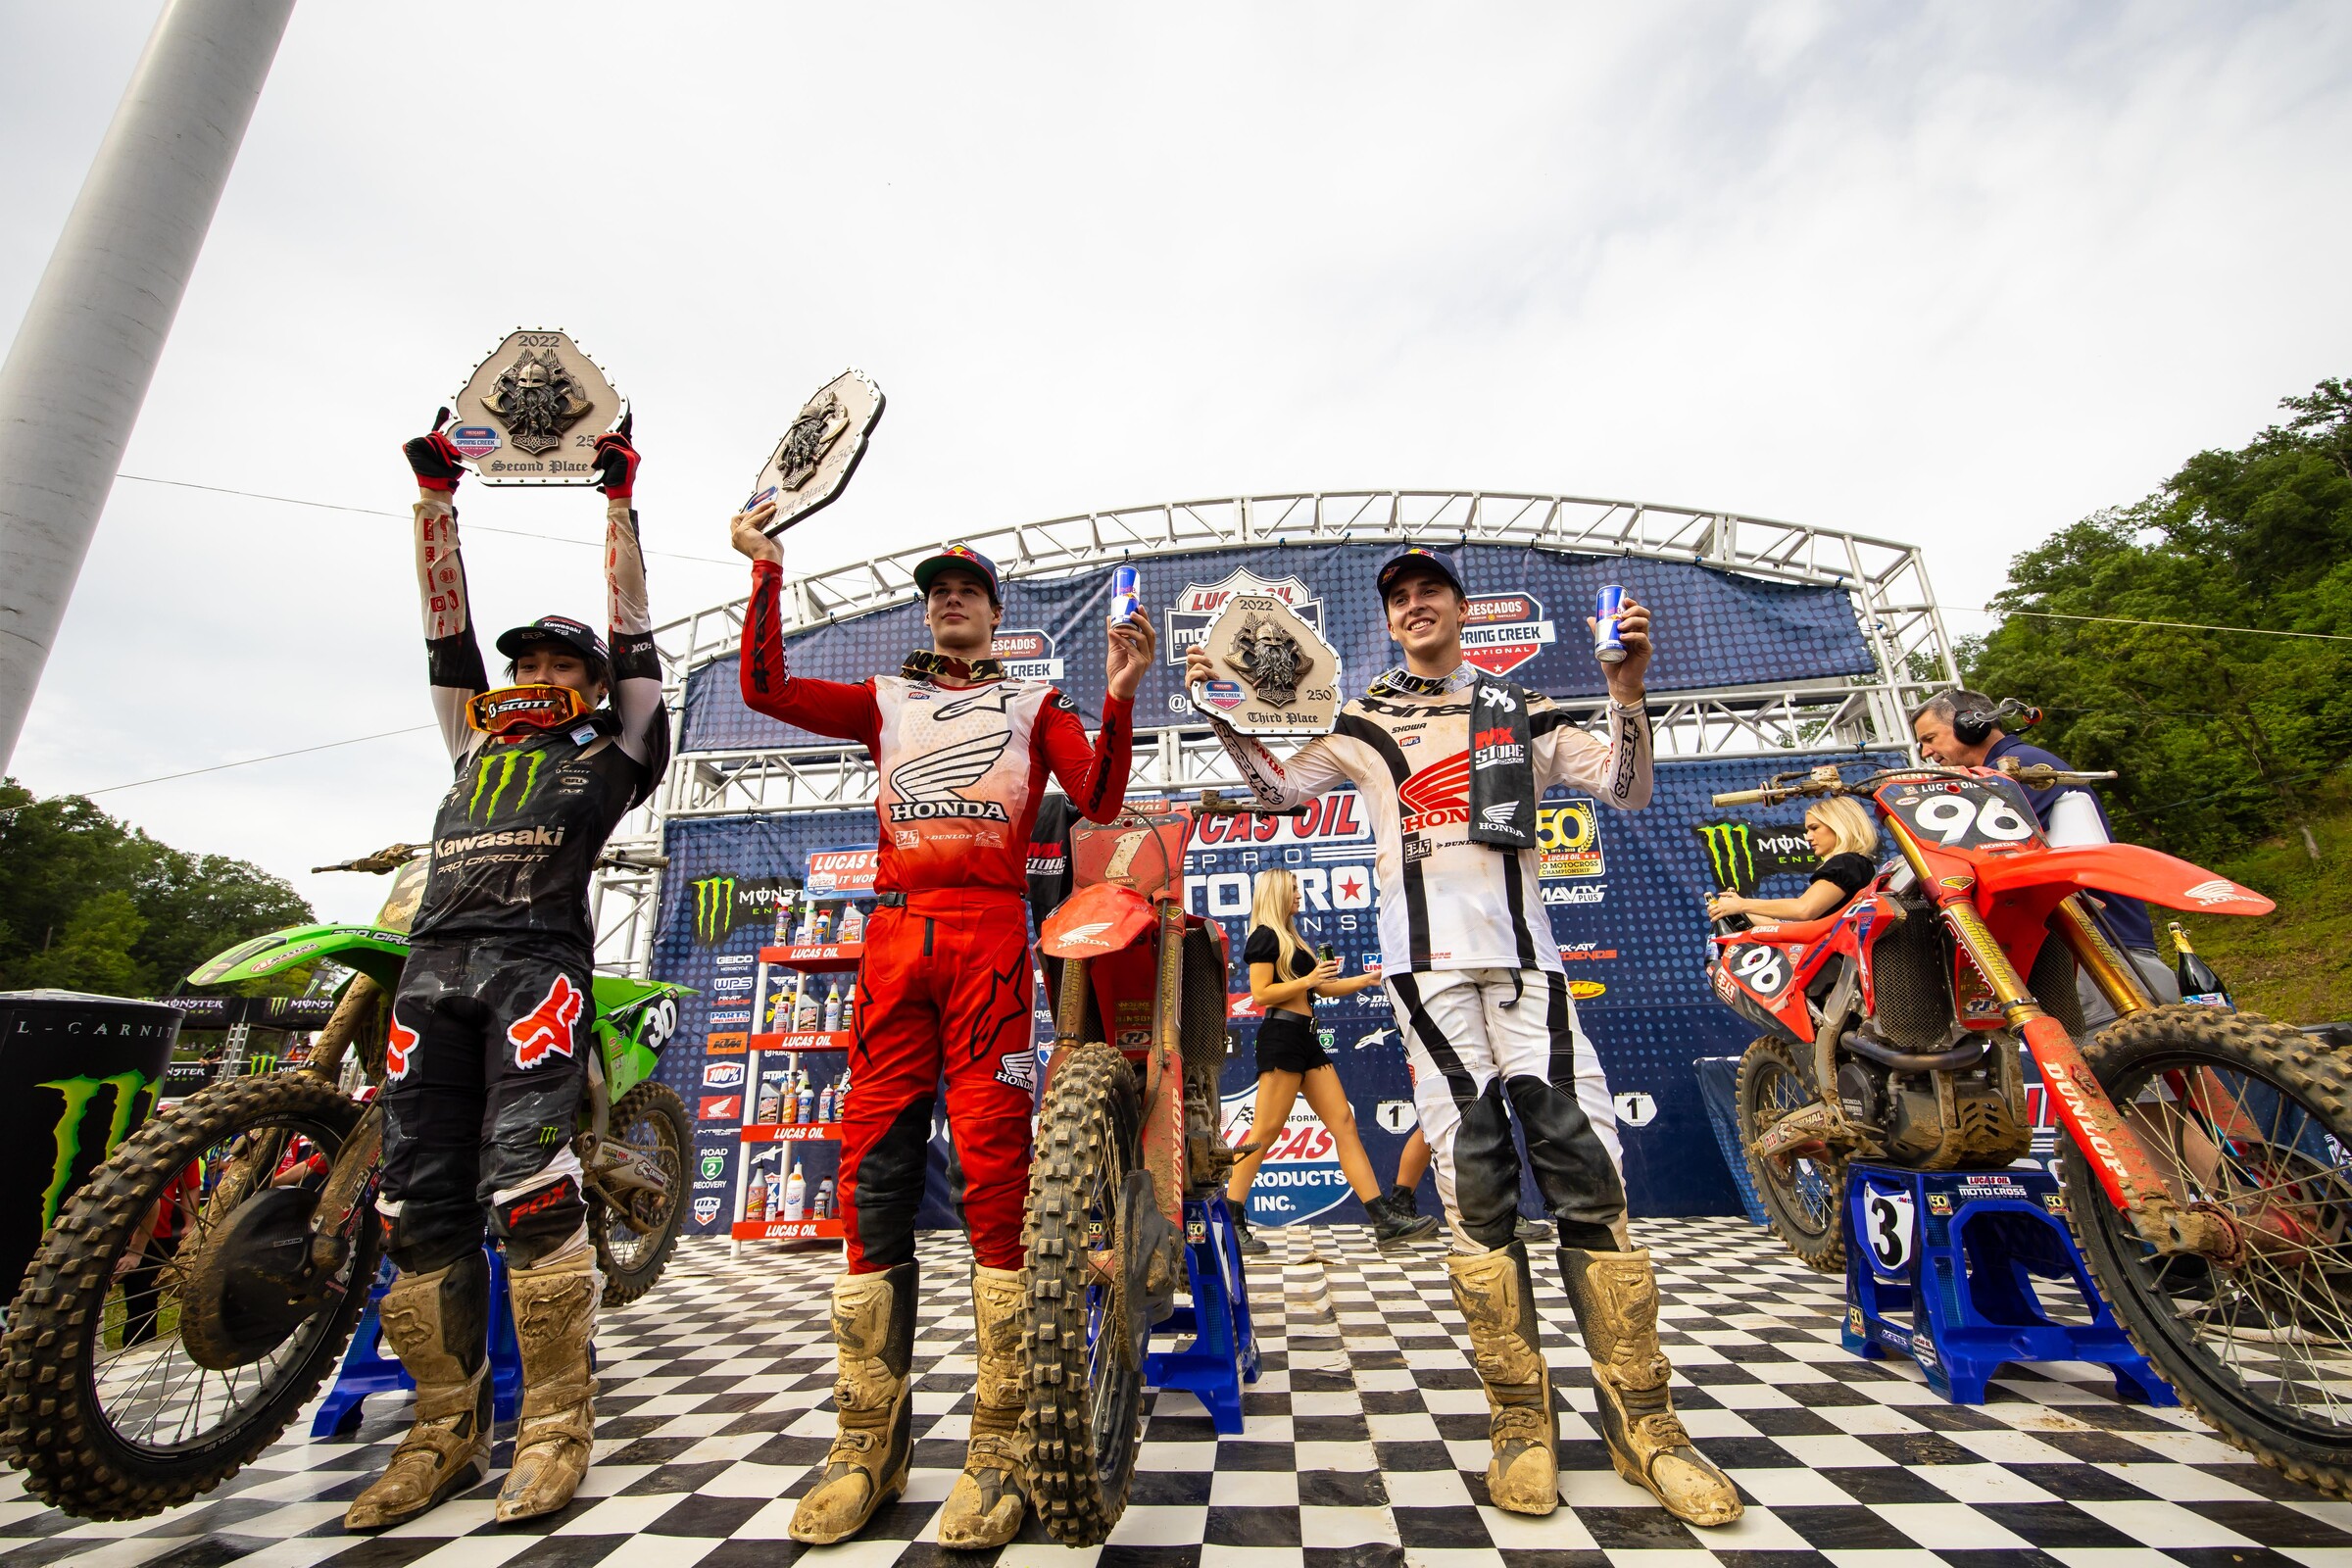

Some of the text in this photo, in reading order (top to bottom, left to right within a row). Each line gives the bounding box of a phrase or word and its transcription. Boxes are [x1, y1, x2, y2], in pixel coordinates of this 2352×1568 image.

[517, 334, 561, 348] 2022
[491, 460, 588, 474] Second Place
[798, 480, 828, 507] Place
[1239, 599, 1274, 612] 2022
[544, 621, 581, 635] Kawasaki
[1497, 625, 1542, 642] CREEK
[1463, 646, 1531, 658] NATIONAL
[1010, 663, 1051, 677] CREEK
[1306, 689, 1332, 701] 250
[497, 699, 556, 711] SCOTT
[1247, 711, 1319, 725] Third Place
[1392, 722, 1428, 734] SHOWA
[1399, 736, 1421, 747] 100%
[1475, 726, 1516, 751] MX
[1475, 744, 1525, 763] STORE
[891, 802, 1007, 821] HONDA
[1292, 794, 1360, 839] OIL
[1915, 795, 2034, 848] 96
[1478, 822, 1526, 838] HONDA
[1537, 808, 1589, 850] 50
[434, 825, 565, 860] Kawasaki
[1979, 841, 2019, 850] HONDA
[1028, 842, 1062, 858] MX
[1103, 829, 1152, 879] 1
[437, 854, 550, 876] PRO CIRCUIT
[813, 854, 868, 871] LUCAS
[1201, 849, 1302, 869] PRO
[1547, 854, 1569, 862] LUCAS
[1550, 860, 1599, 869] MOTOCROSS
[1542, 867, 1591, 876] CHAMPIONSHIP
[838, 875, 850, 884] IT
[1055, 938, 1110, 950] HONDA
[791, 947, 839, 958] LUCAS OIL
[716, 956, 754, 965] GEICO
[1733, 945, 1783, 993] 96
[714, 977, 753, 990] WPS
[643, 999, 677, 1049] 30
[712, 1038, 742, 1049] KTM
[782, 1035, 832, 1047] LUCAS OIL
[1324, 1036, 1331, 1045] 2
[709, 1066, 739, 1082] 100%
[2042, 1061, 2130, 1178] DUNLOP
[773, 1127, 825, 1139] LUCAS OIL
[700, 1148, 728, 1156] ROAD
[1172, 1087, 1184, 1209] DUNLOP
[707, 1163, 716, 1177] 2
[693, 1180, 727, 1190] RECOVERY
[508, 1180, 568, 1229] FOX
[1931, 1194, 1947, 1207] 50
[2048, 1194, 2064, 1207] 50
[764, 1224, 818, 1237] LUCAS OIL
[1189, 1224, 1203, 1235] 50
[1871, 1197, 1903, 1267] 3
